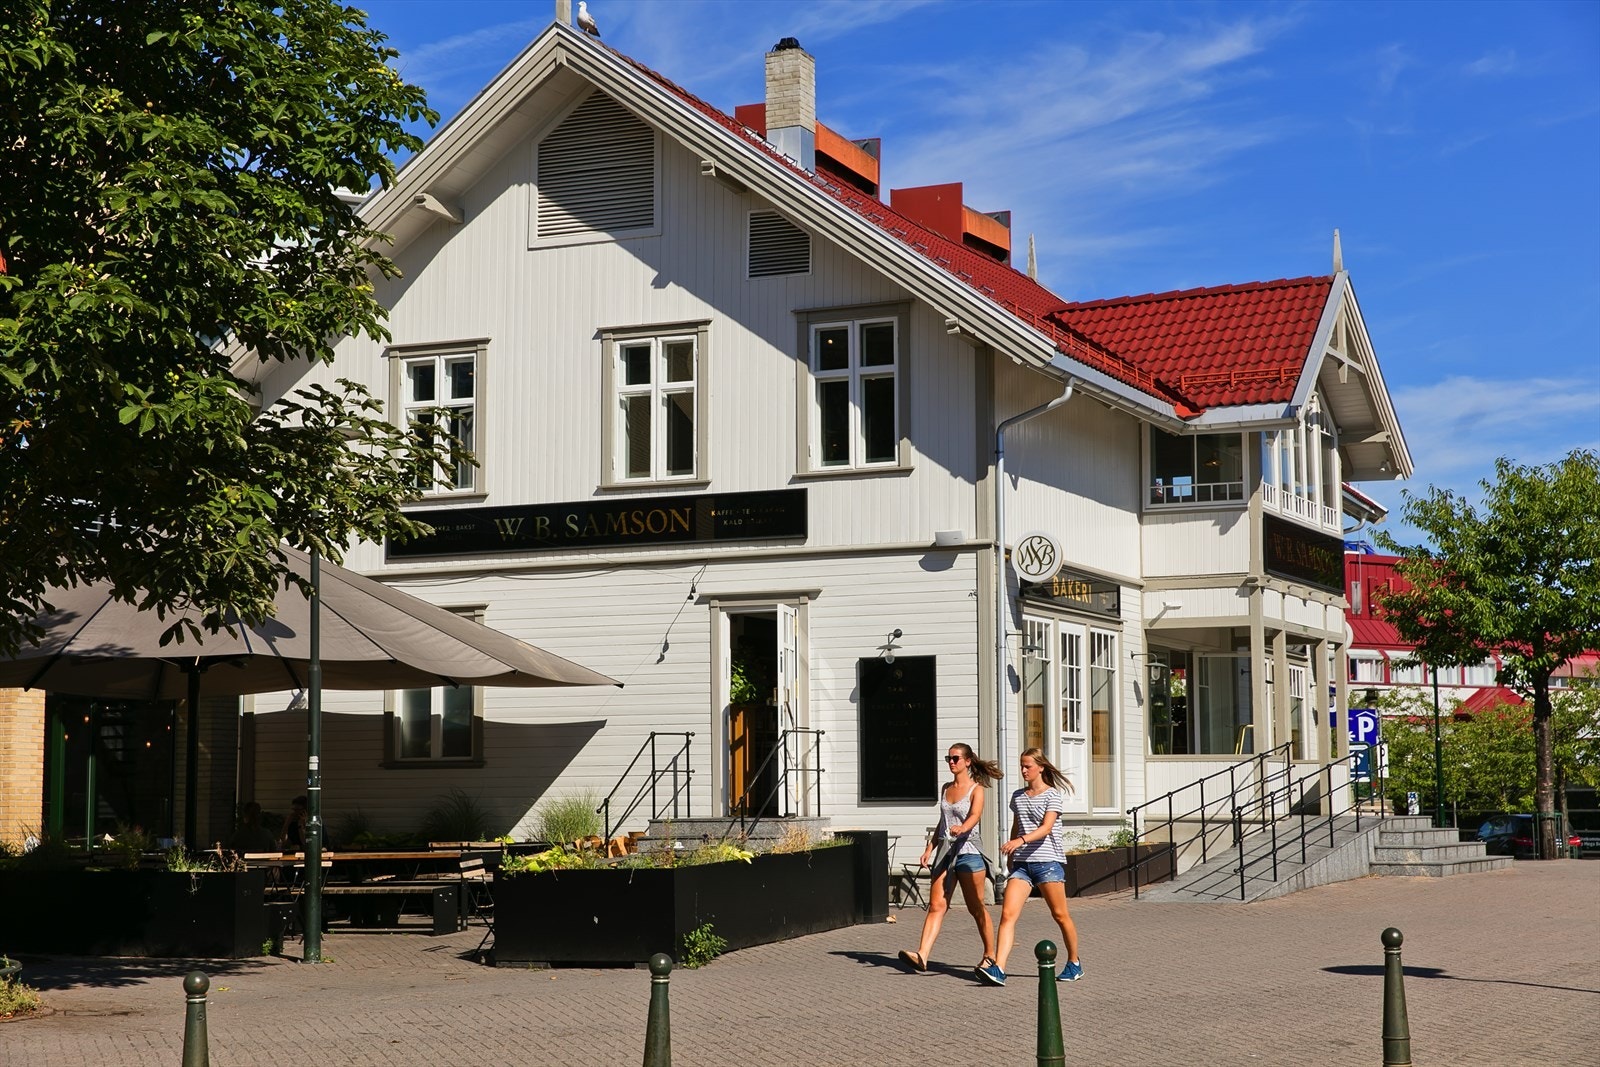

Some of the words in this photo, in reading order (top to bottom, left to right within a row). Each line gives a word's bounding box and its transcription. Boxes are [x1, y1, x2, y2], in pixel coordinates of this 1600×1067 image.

[494, 517, 526, 541] W.
[534, 514, 558, 538] B.
[565, 508, 692, 538] SAMSON
[1053, 576, 1092, 604] BAKERI
[1358, 717, 1374, 741] P
